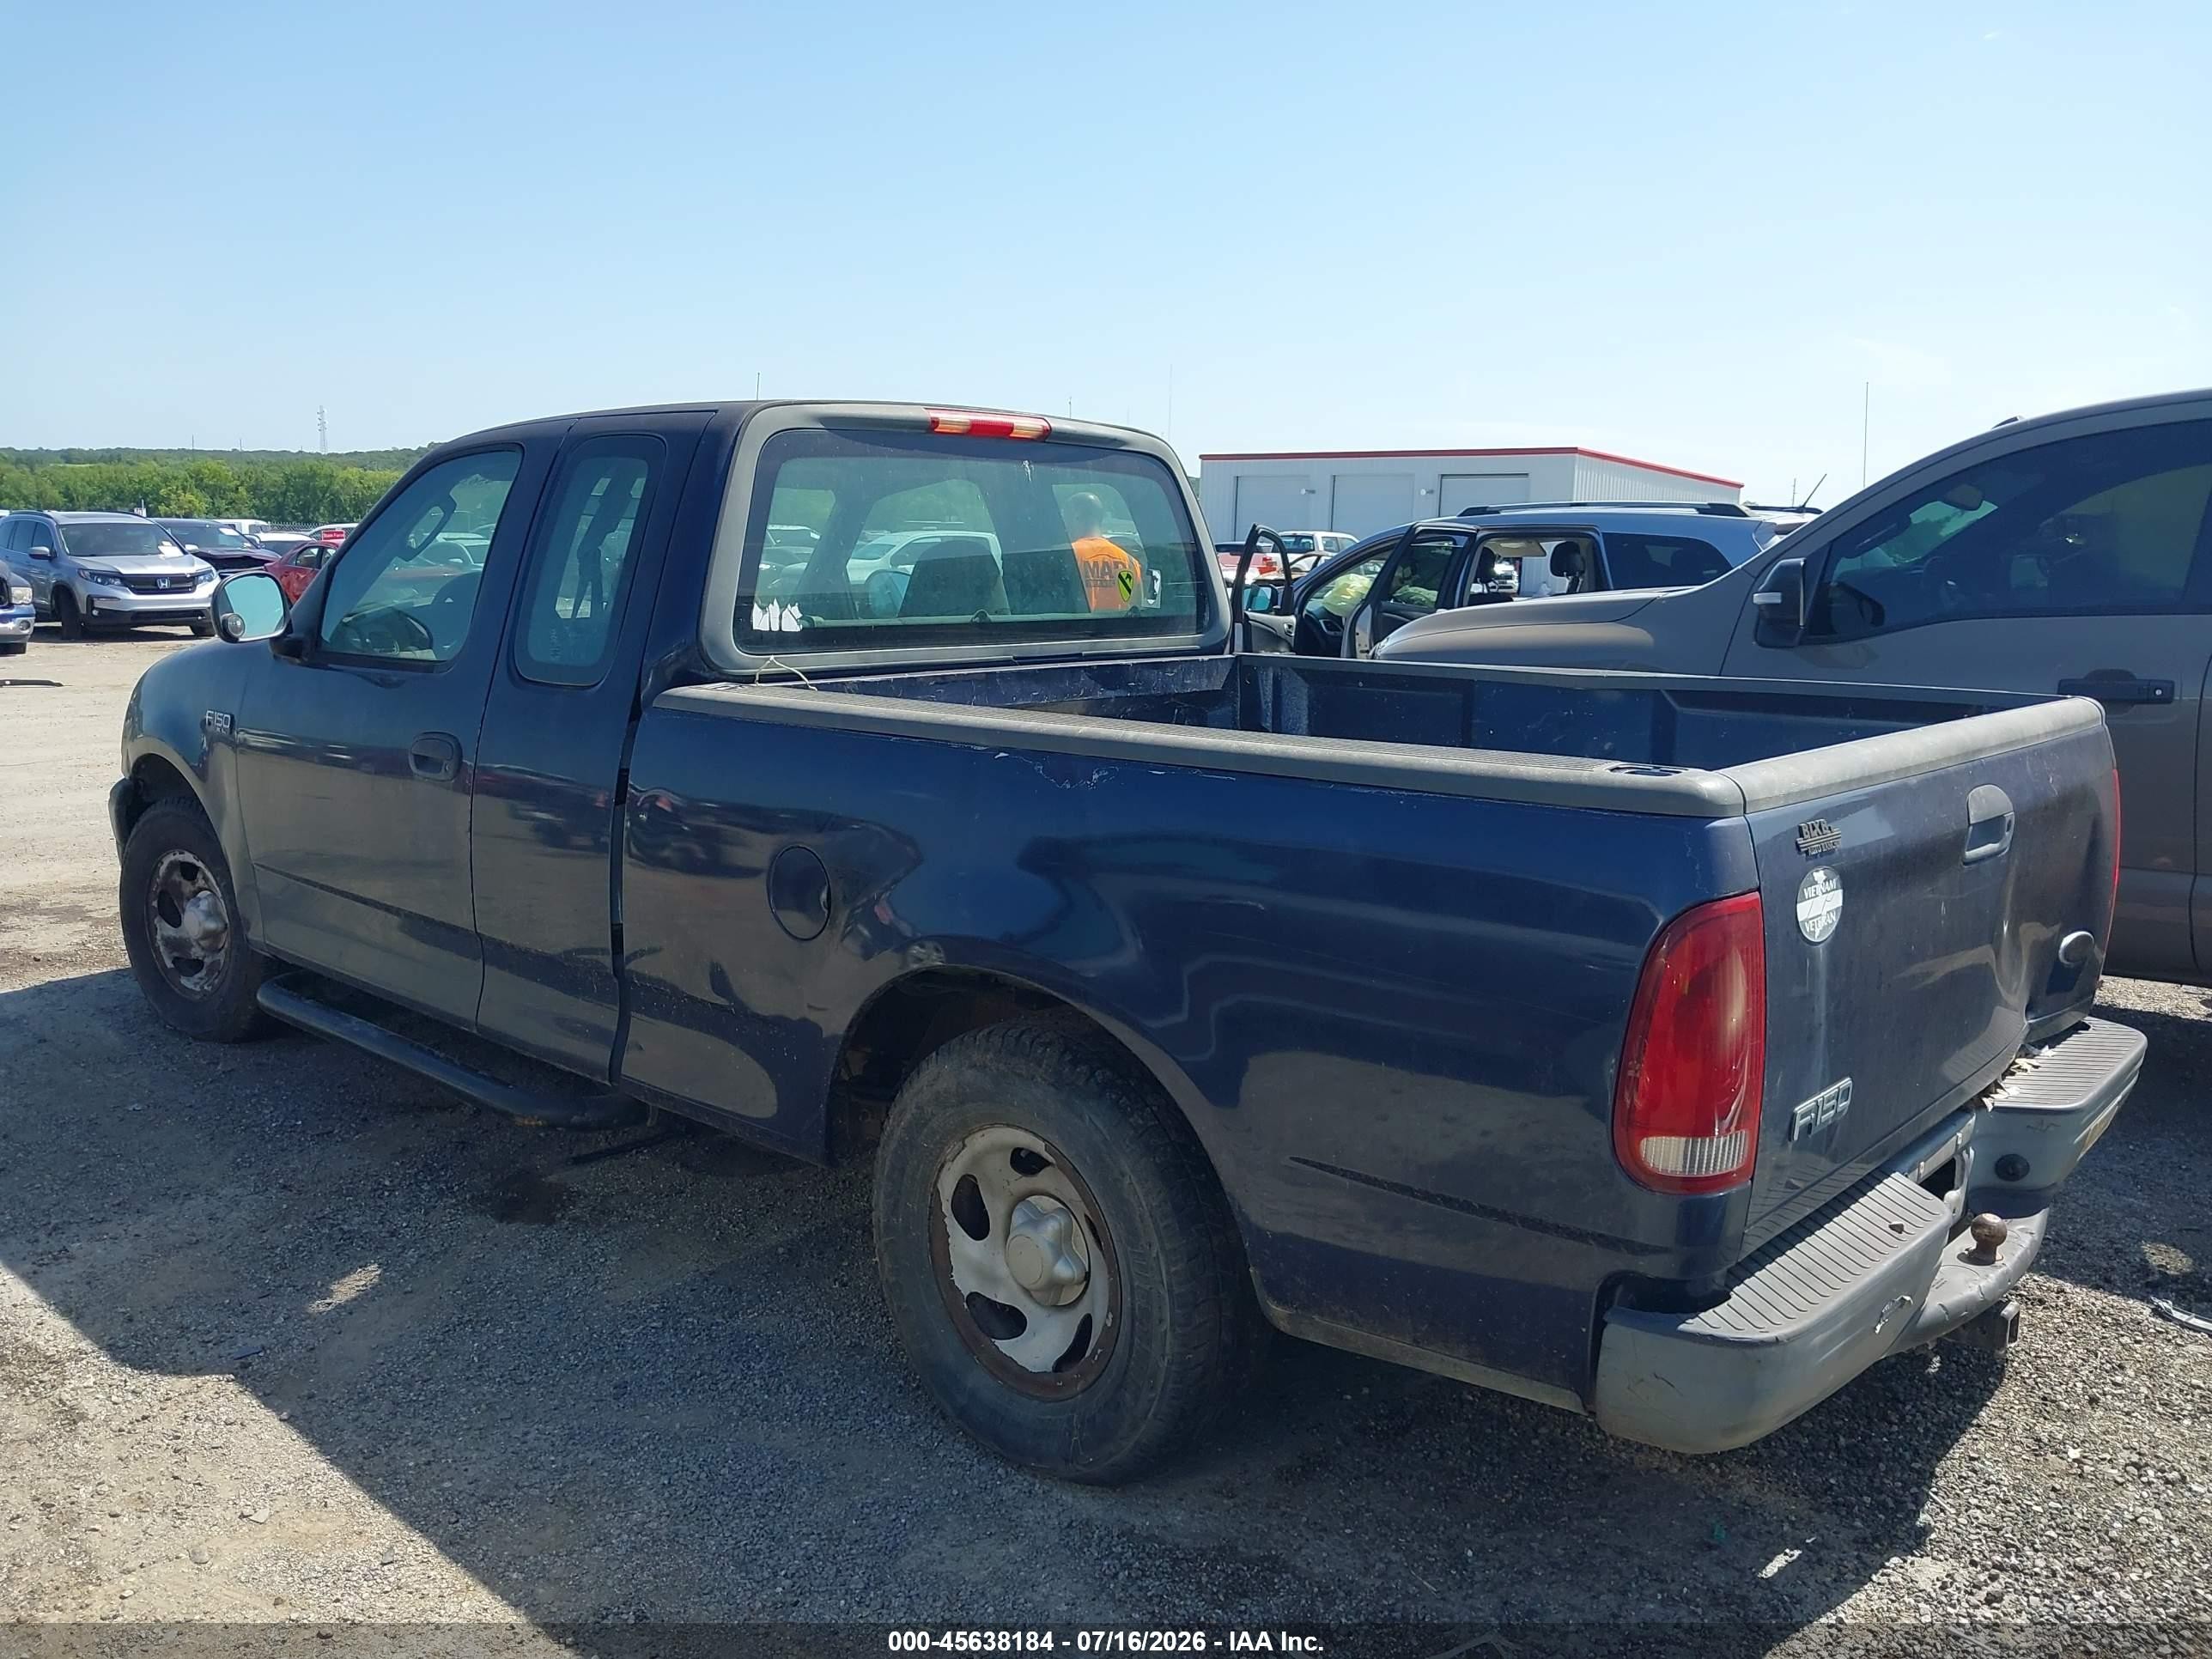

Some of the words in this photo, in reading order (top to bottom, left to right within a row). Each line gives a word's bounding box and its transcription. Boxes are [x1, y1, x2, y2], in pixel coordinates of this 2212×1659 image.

[206, 710, 231, 728] F150
[1803, 878, 1837, 899] VIETNAM
[1793, 1078, 1853, 1141] F150
